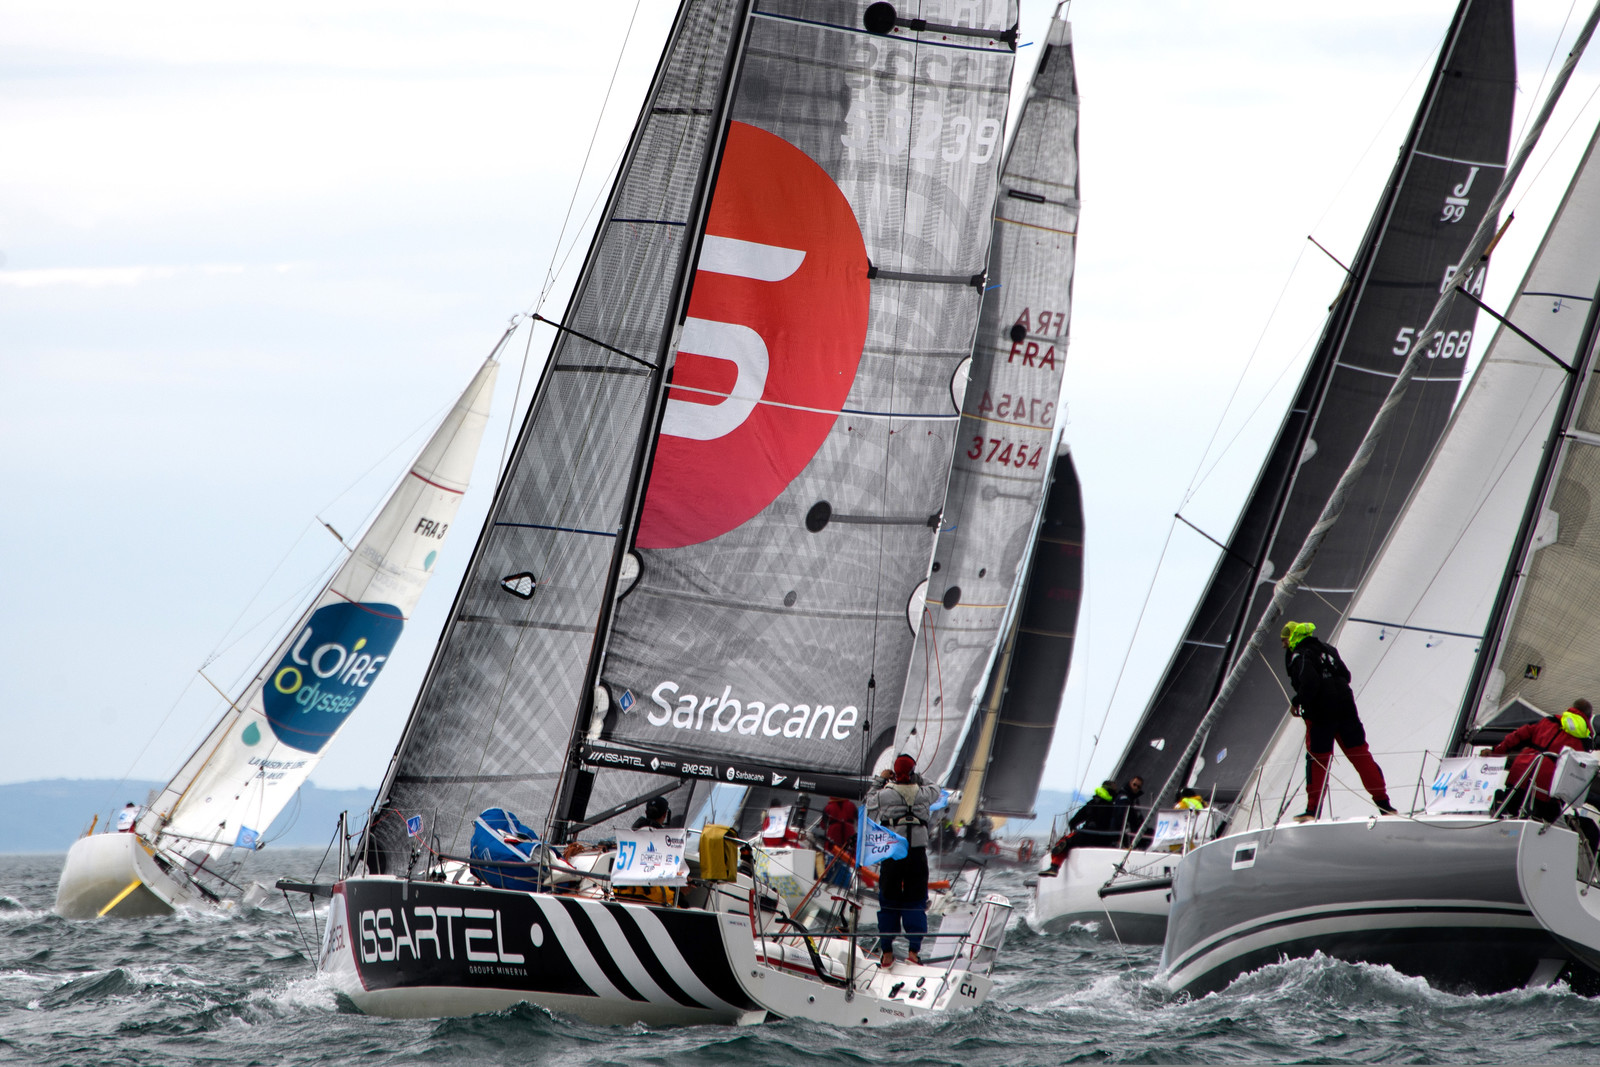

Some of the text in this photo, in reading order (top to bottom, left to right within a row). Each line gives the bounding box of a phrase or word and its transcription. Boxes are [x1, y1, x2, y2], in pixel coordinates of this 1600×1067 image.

[1454, 167, 1479, 197] J
[1440, 205, 1466, 223] 99
[1008, 341, 1056, 370] FRA
[1393, 327, 1472, 358] 5368
[968, 436, 1043, 470] 37454
[414, 517, 449, 540] FRA 3
[274, 667, 356, 714] Odyssée
[647, 681, 858, 740] Sarbacane
[604, 753, 645, 767] ISSARTEL
[681, 763, 698, 775] axe
[735, 771, 765, 782] Sarbacane
[1432, 771, 1453, 797] 44
[616, 841, 637, 870] 57
[871, 844, 890, 854] CUP
[358, 906, 525, 964] ISSARTEL
[469, 965, 528, 977] GROUPE MINERVA
[960, 983, 977, 999] CH
